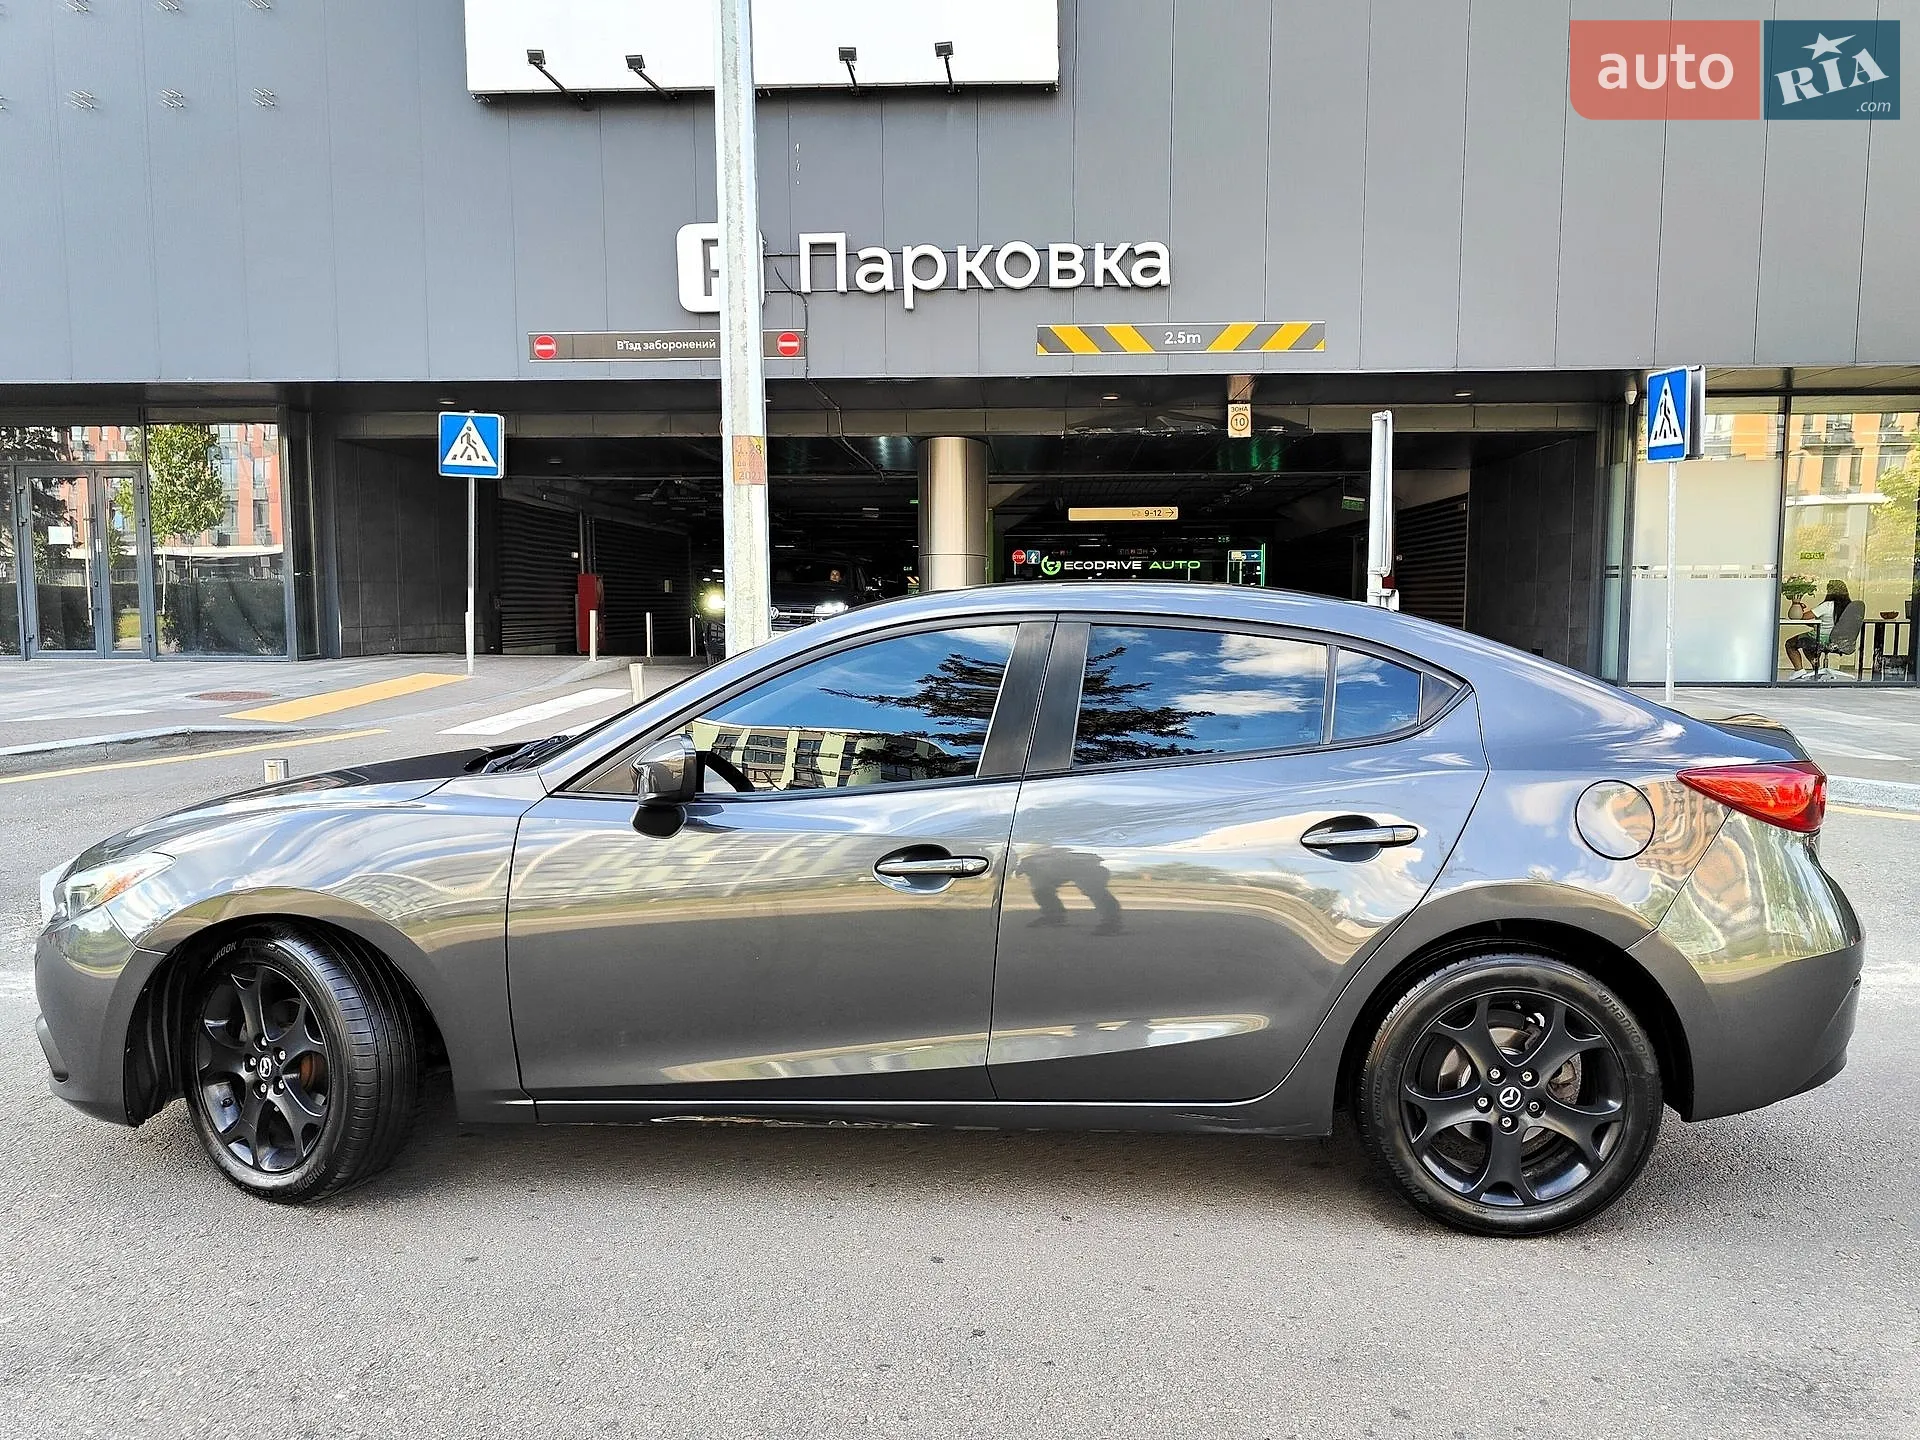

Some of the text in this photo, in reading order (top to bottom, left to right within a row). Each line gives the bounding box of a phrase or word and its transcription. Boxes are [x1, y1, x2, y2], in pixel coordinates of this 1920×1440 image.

[798, 231, 1171, 310] Парковка
[1164, 331, 1201, 345] 2.5m
[643, 338, 716, 352] заборонений
[1234, 417, 1246, 427] 10
[1144, 509, 1162, 517] 9-12
[1063, 560, 1201, 570] ECODRIVE AUTO
